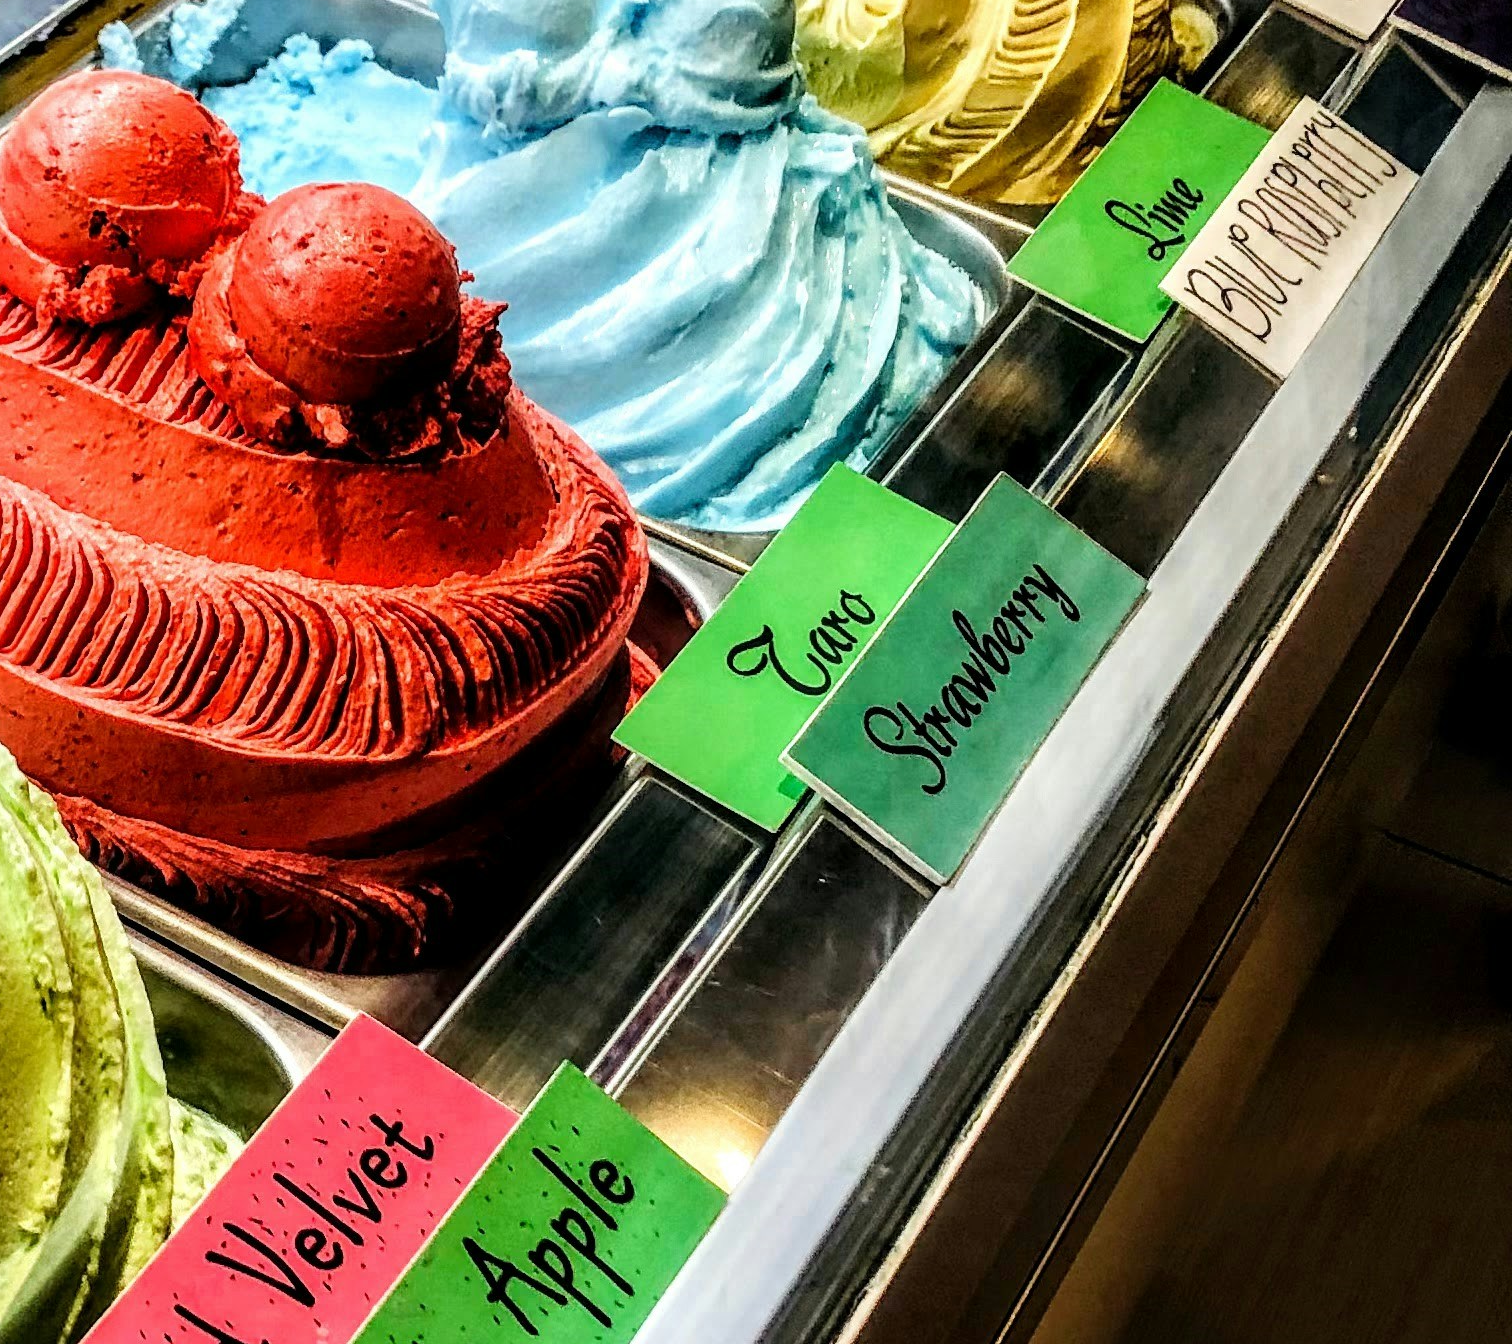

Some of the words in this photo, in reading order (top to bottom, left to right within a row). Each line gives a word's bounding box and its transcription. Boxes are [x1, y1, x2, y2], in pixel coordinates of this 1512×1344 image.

[1104, 176, 1205, 261] Lime
[726, 588, 876, 696] Taro
[863, 563, 1081, 795] Strawberry
[204, 1112, 436, 1308] Velvet
[462, 1146, 637, 1336] Apple
